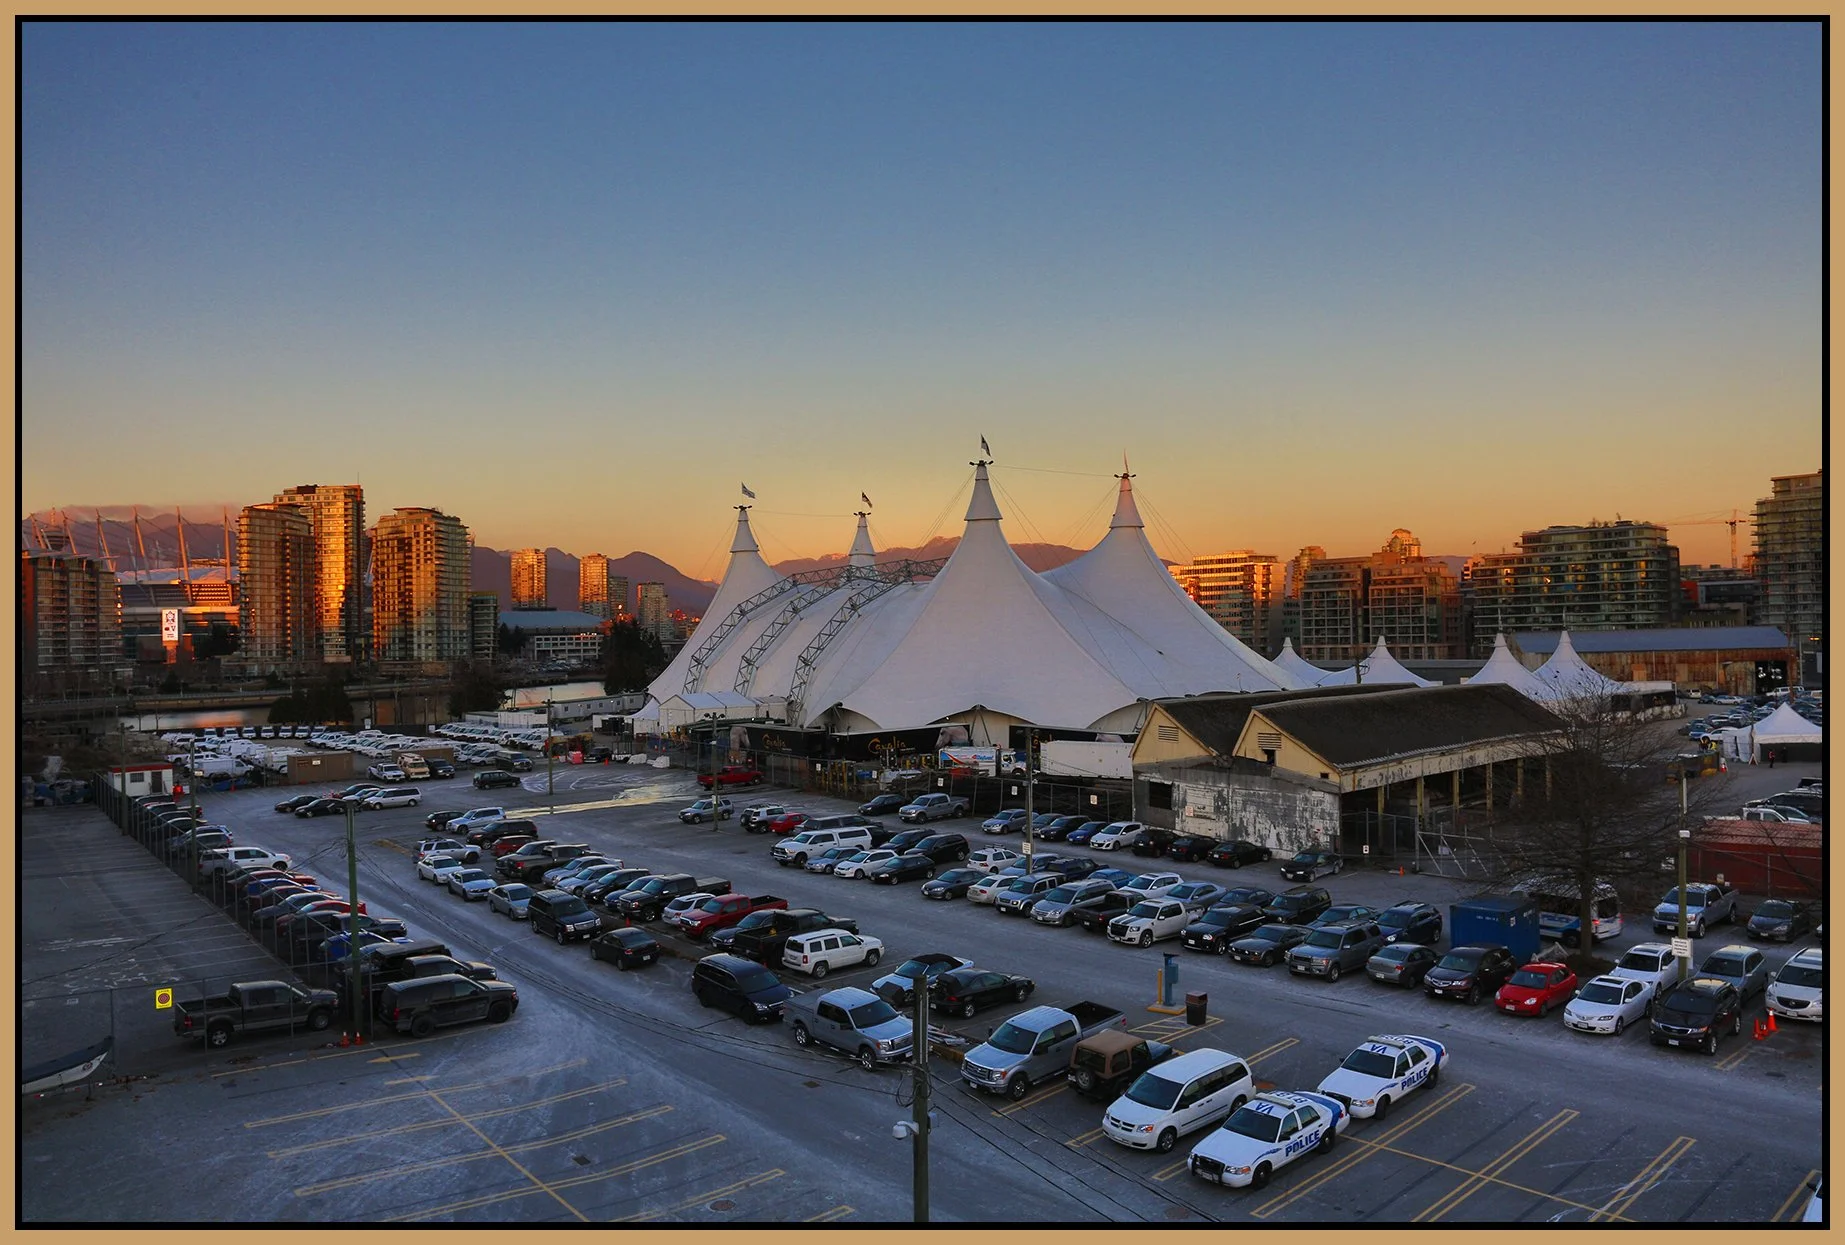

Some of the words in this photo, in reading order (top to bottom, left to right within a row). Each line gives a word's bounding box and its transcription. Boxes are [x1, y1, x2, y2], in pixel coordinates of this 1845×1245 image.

[867, 736, 907, 755] Cavalia
[1370, 1044, 1387, 1054] VA
[1401, 1067, 1427, 1091] POLICE
[1255, 1102, 1274, 1115] VA
[1285, 1129, 1320, 1157] POLICE
